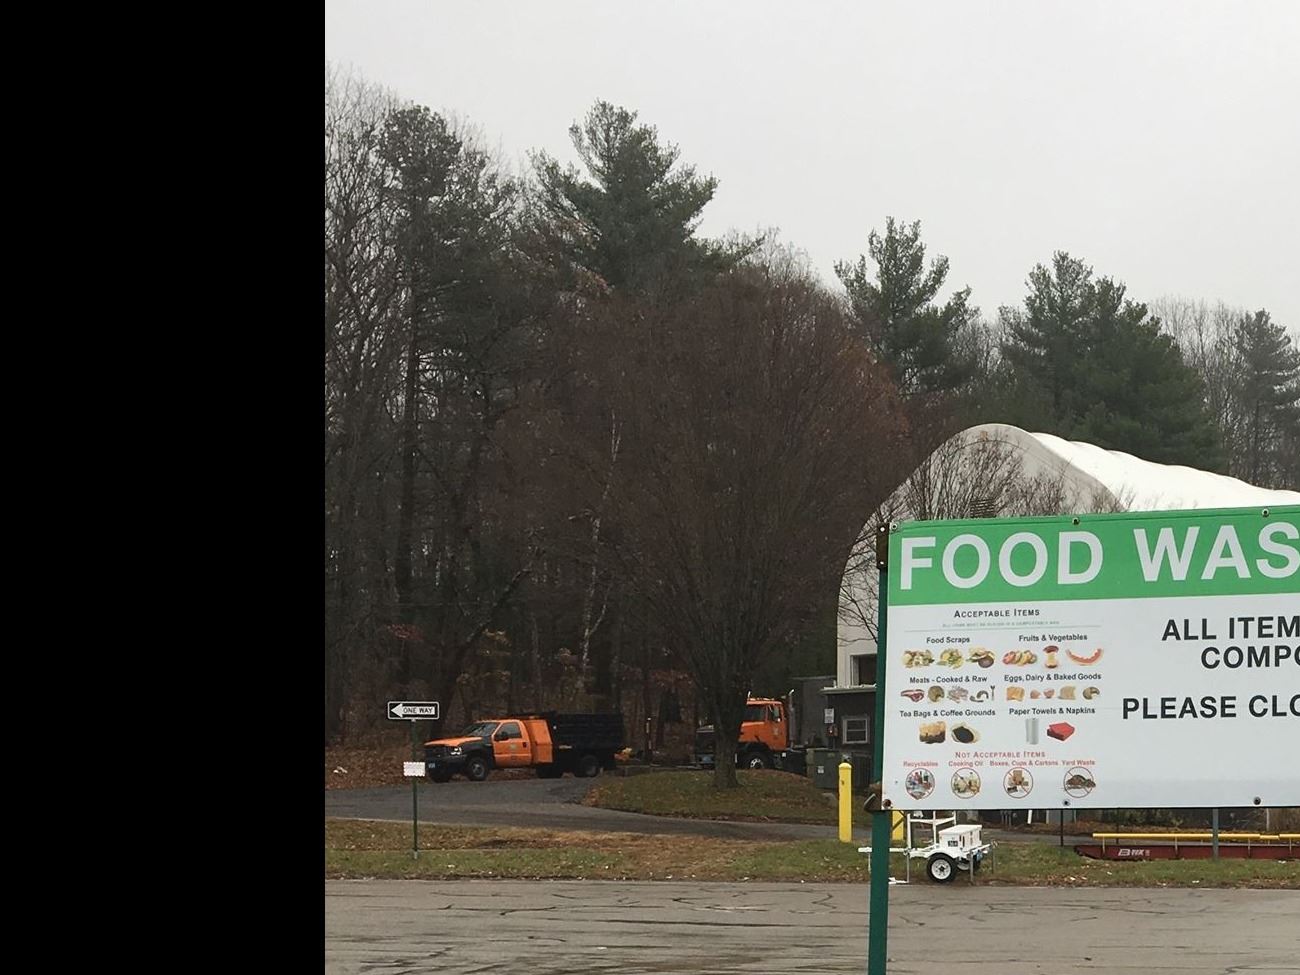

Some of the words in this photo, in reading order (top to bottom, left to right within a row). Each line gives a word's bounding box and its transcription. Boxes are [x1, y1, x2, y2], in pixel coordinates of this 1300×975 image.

[900, 531, 1103, 590] FOOD
[954, 609, 1010, 618] ACCEPTABLE
[1013, 608, 1040, 617] ITEMS
[1162, 618, 1217, 641] ALL
[946, 636, 970, 644] Scraps
[1048, 633, 1088, 642] Vegetables
[1026, 674, 1043, 682] Dairy
[1009, 708, 1031, 716] Paper
[1122, 696, 1237, 720] PLEASE
[913, 710, 931, 718] Bags
